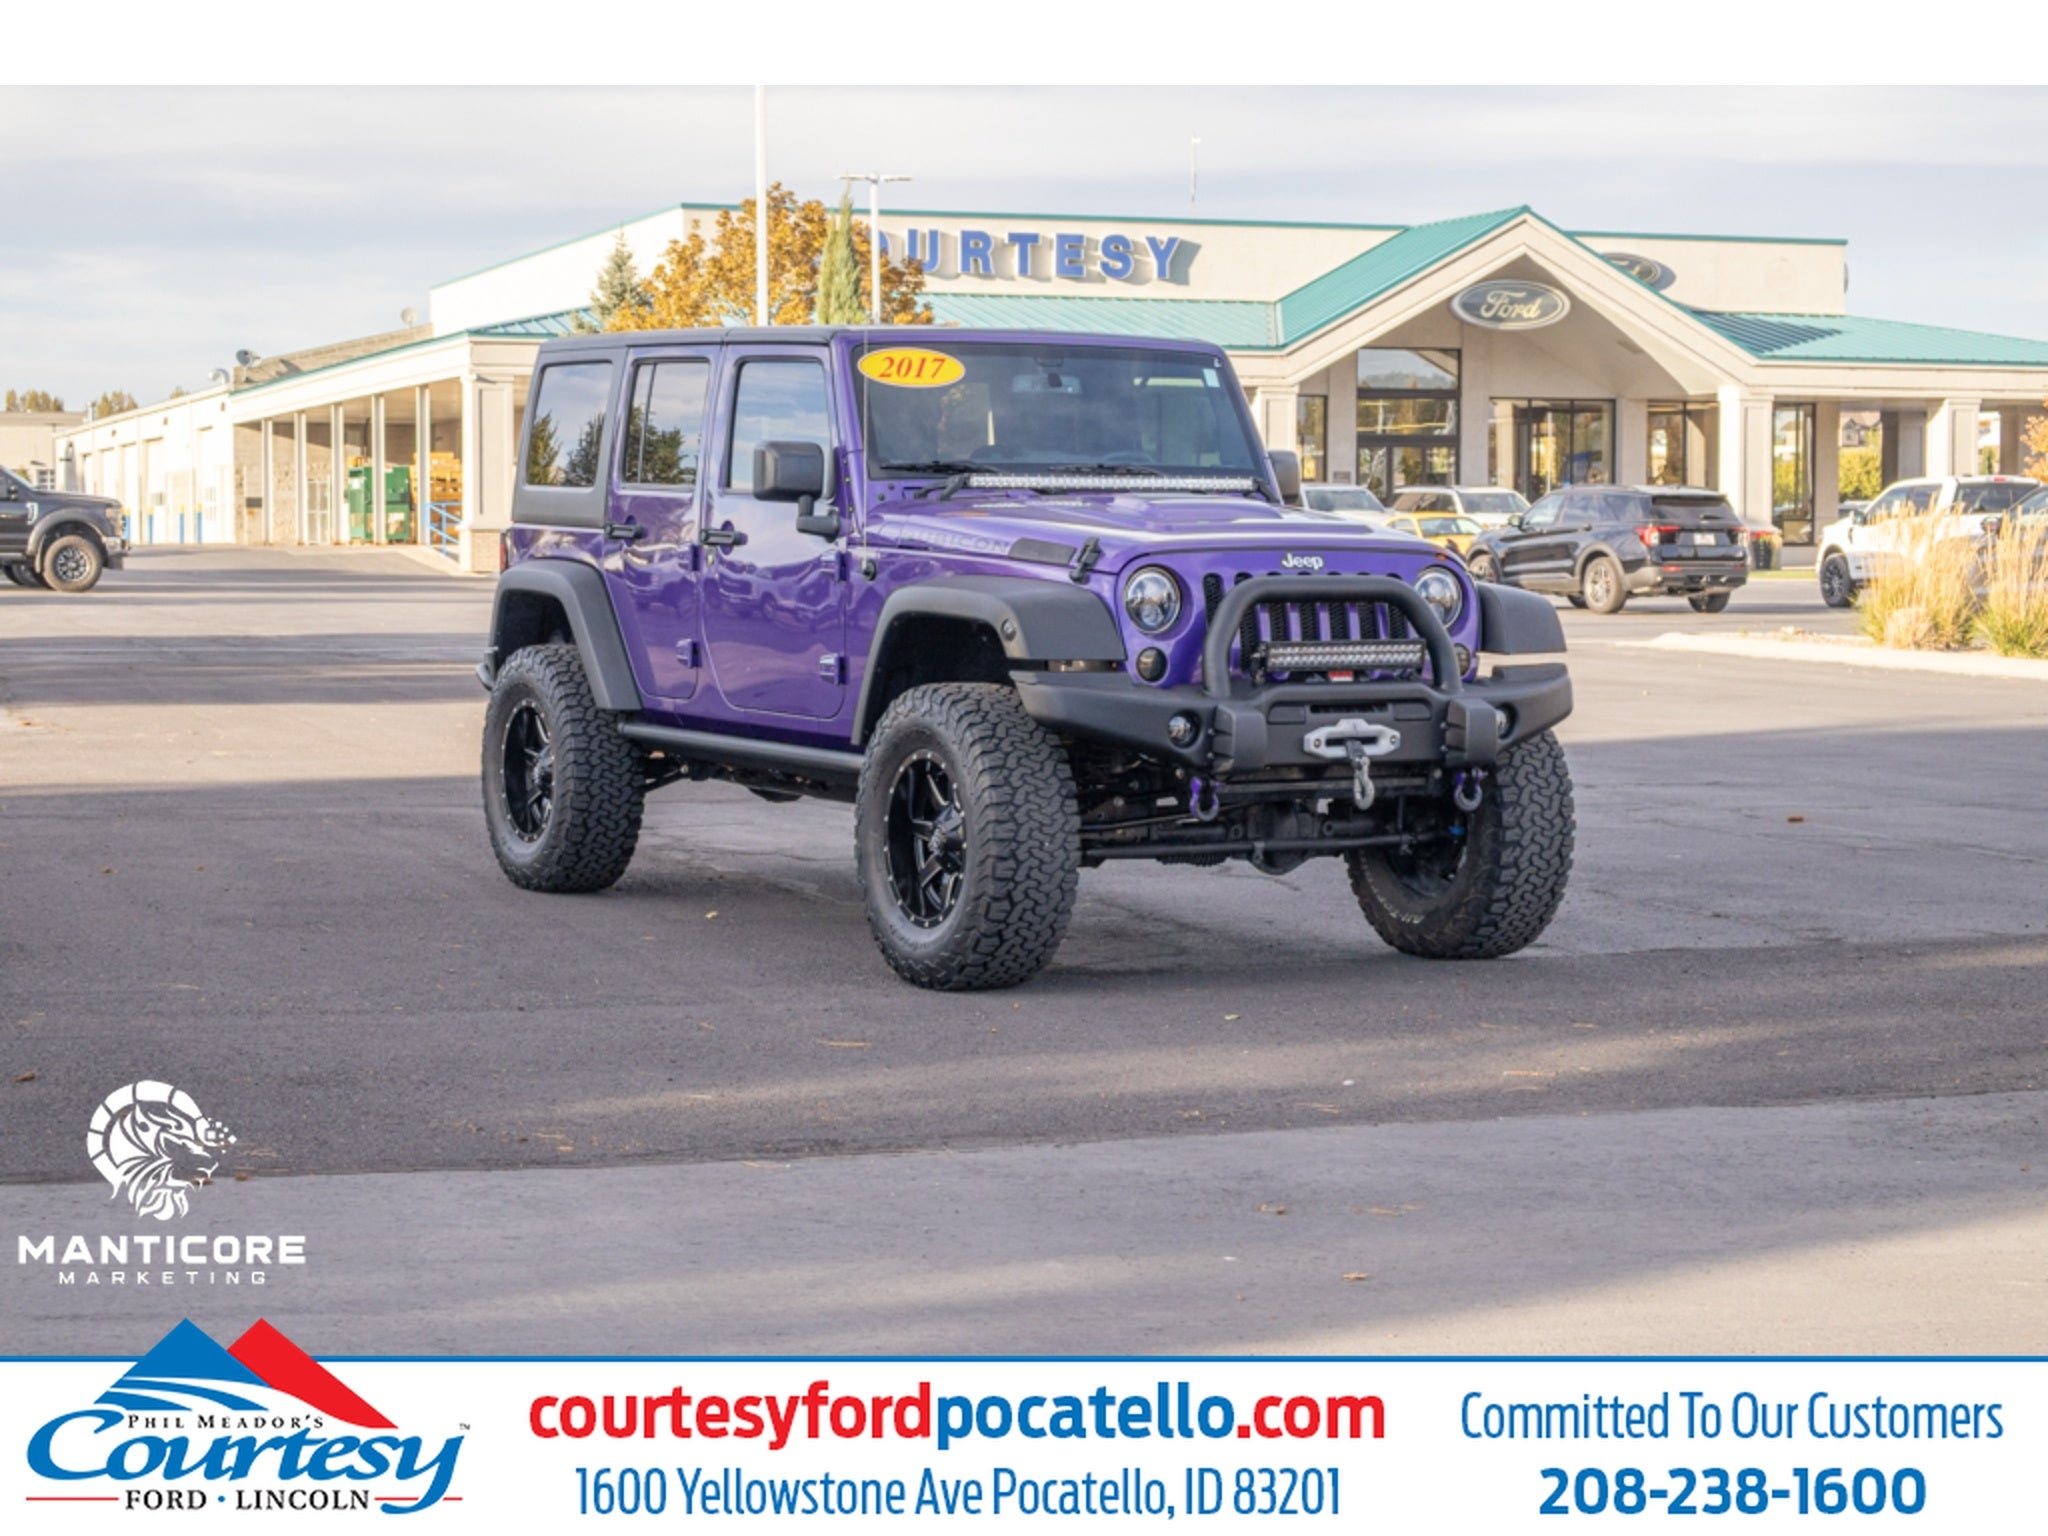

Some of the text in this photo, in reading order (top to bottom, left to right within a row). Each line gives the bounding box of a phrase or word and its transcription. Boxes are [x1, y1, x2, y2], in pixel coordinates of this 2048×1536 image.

[1480, 290, 1543, 319] Ford
[878, 356, 947, 379] 2017
[1281, 552, 1324, 571] Jeep
